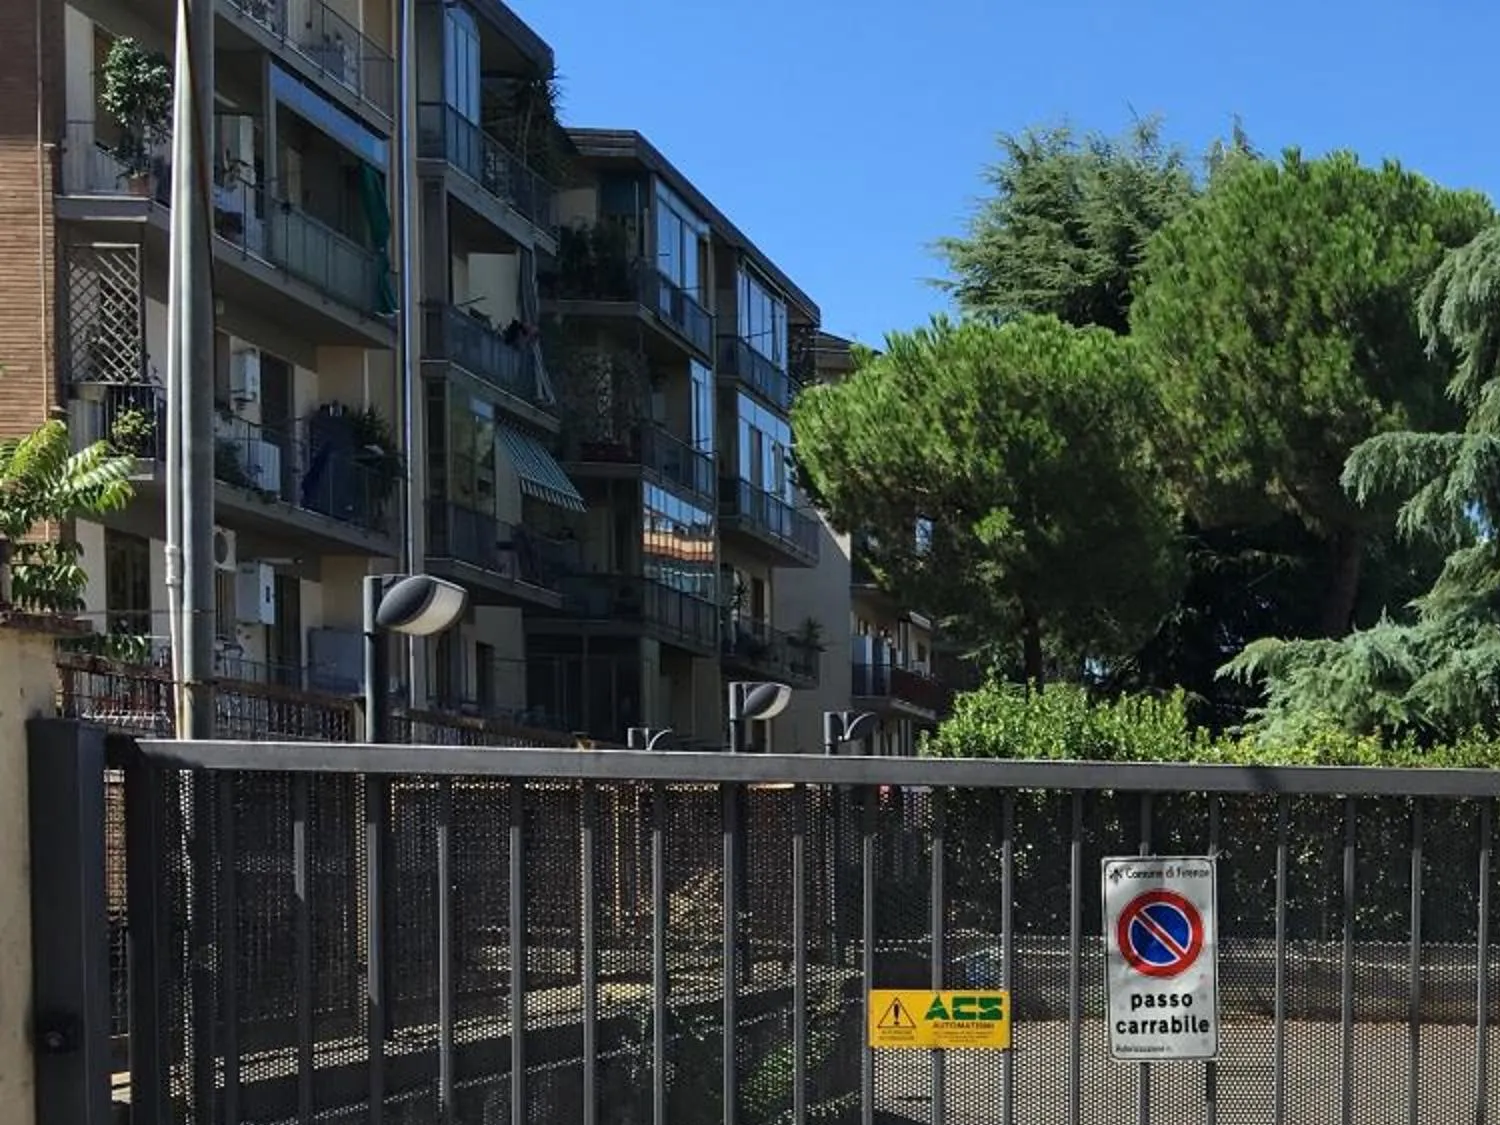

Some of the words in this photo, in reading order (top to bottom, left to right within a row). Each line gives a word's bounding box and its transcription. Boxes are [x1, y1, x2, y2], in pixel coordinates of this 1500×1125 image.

[924, 992, 1003, 1020] ACS
[1131, 993, 1193, 1012] passo
[1115, 1015, 1210, 1034] carrabile
